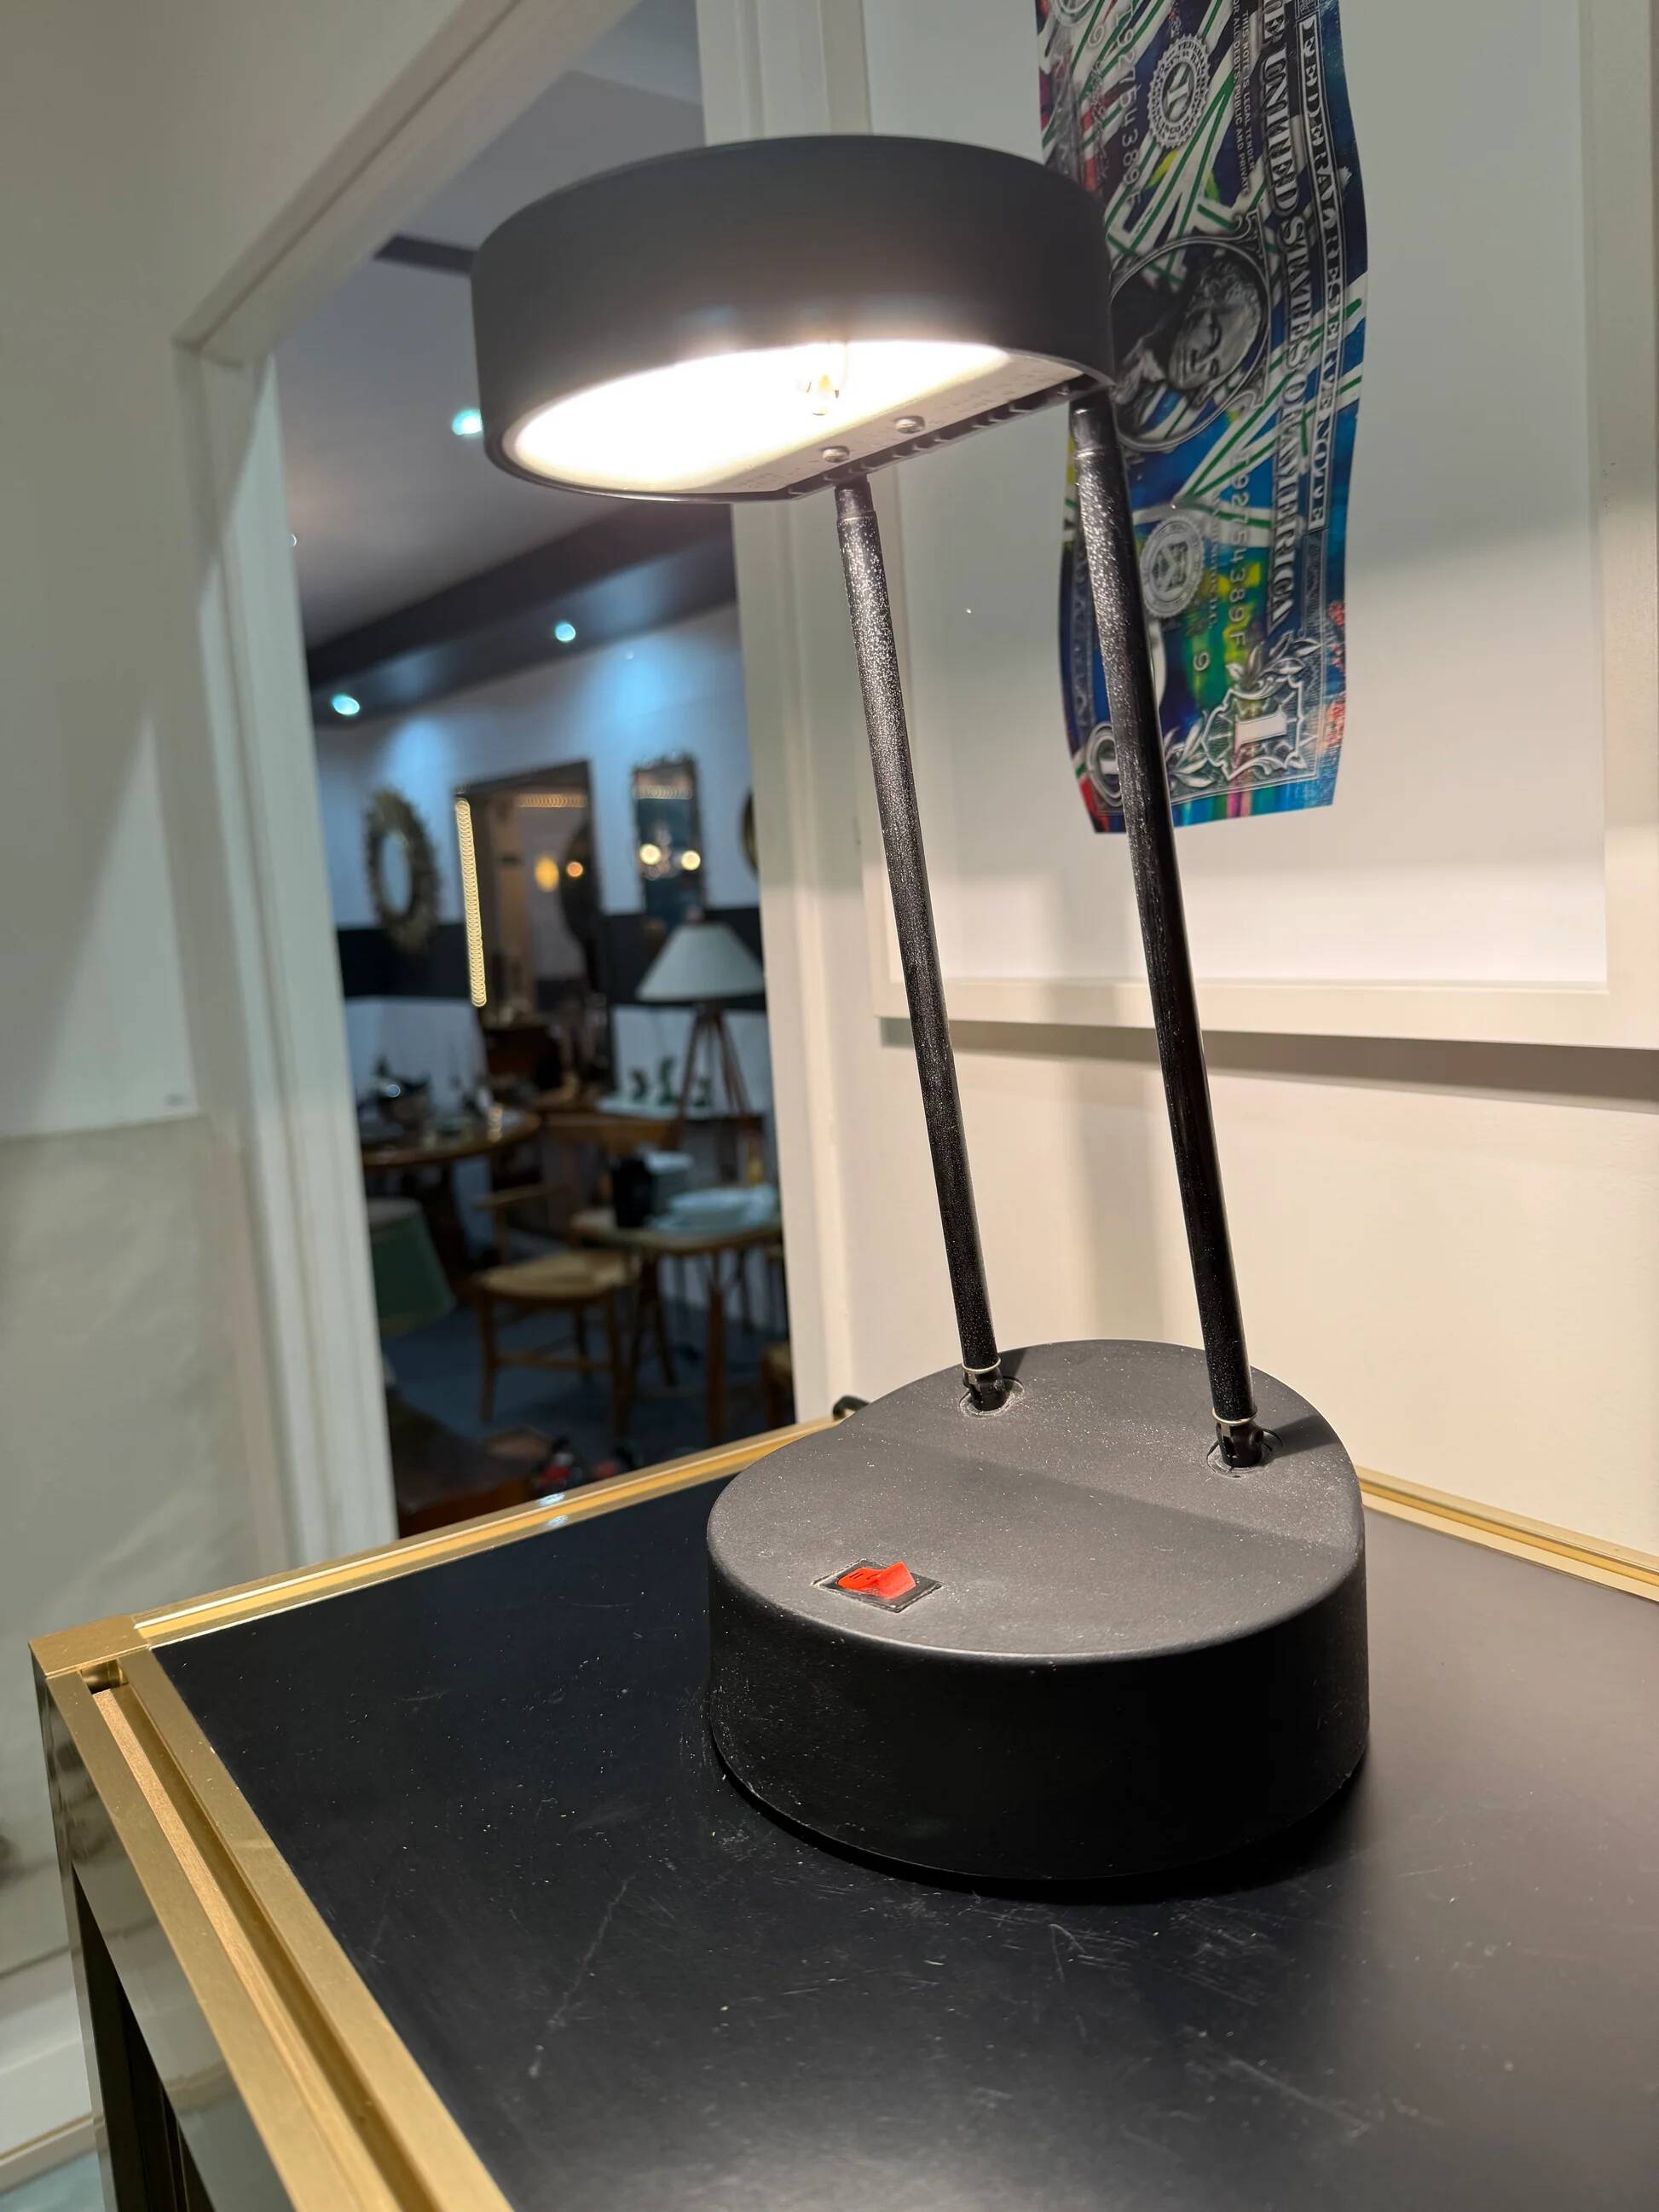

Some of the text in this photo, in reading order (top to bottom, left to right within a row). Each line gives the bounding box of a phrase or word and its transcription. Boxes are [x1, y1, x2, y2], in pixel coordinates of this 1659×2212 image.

[1234, 85, 1243, 125] PUBLIC
[1239, 153, 1249, 193] PRIVATE
[1243, 74, 1250, 89] IS
[1264, 48, 1298, 211] UNITED
[1282, 216, 1312, 368] STATES
[1303, 23, 1342, 523] FEDERAL RESERVE NOTE
[1280, 372, 1306, 426] OF
[1269, 426, 1300, 628] AMERICA
[1194, 651, 1210, 672] 9
